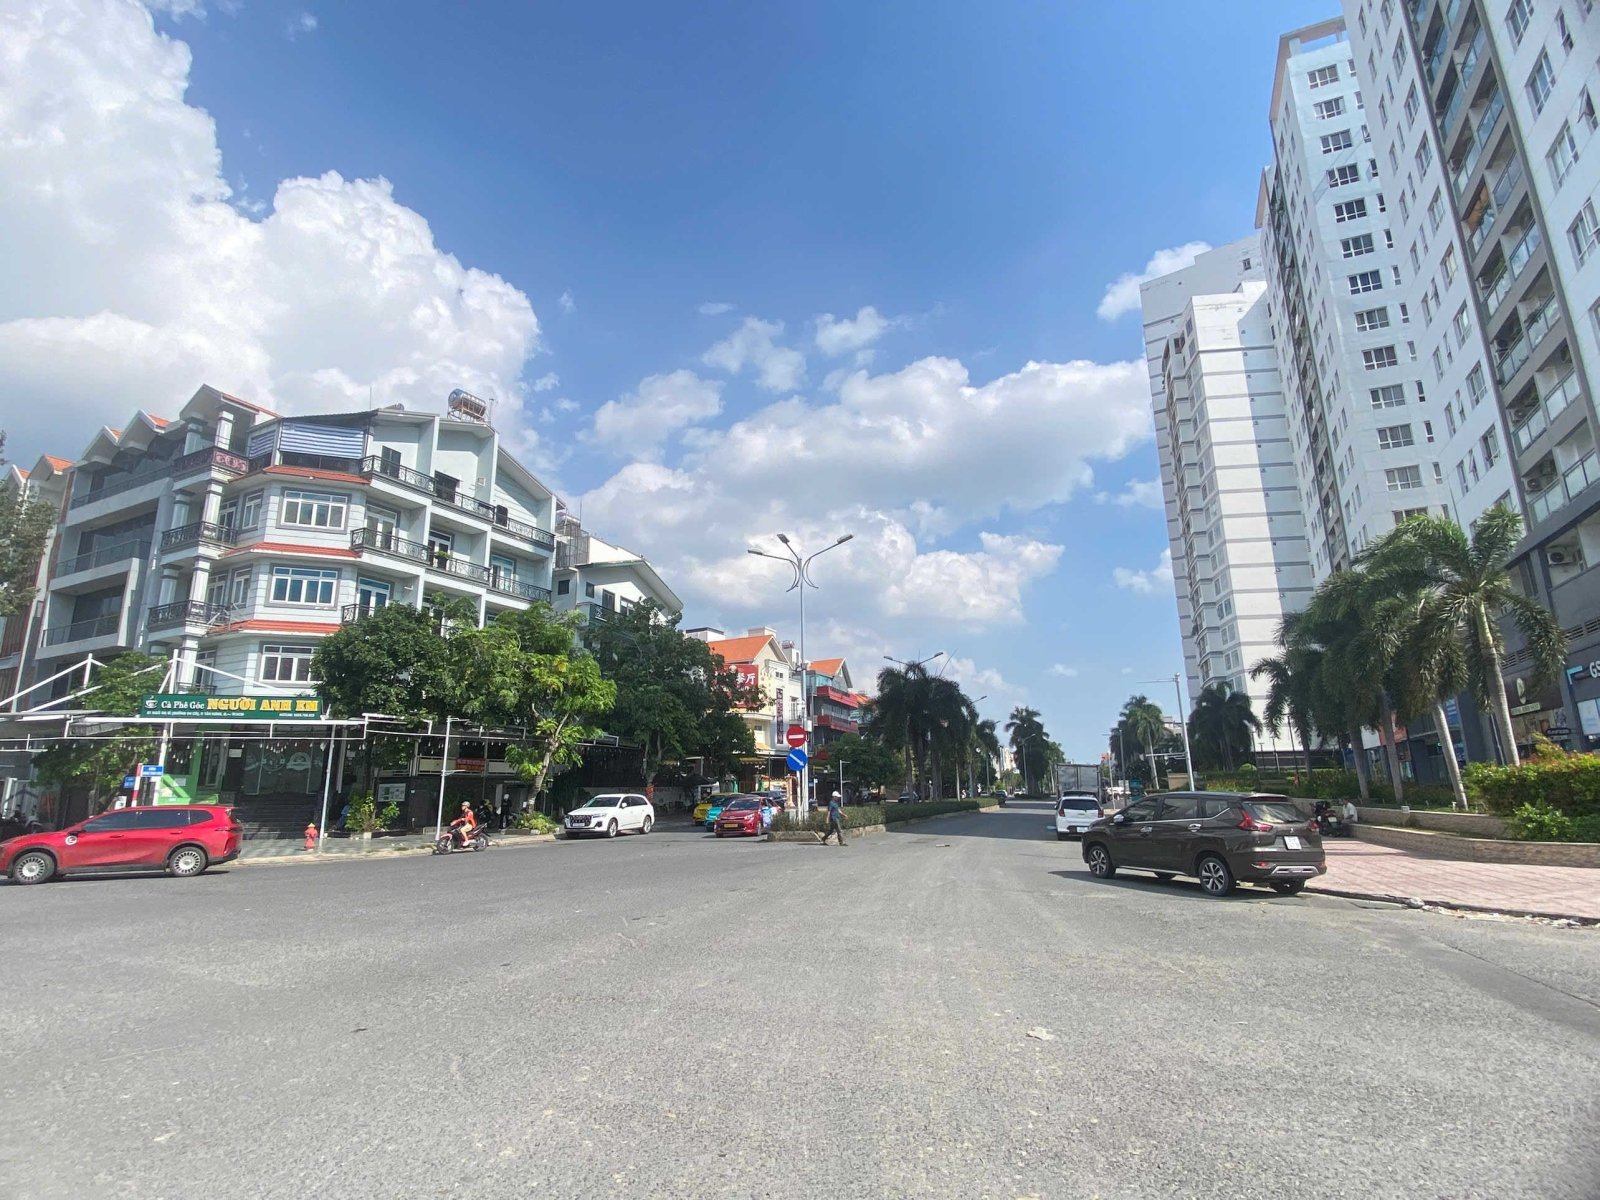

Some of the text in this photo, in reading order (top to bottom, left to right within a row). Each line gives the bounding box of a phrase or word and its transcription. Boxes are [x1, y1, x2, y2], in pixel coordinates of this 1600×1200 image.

[161, 700, 172, 709] Cà
[174, 701, 188, 709] Phê
[189, 701, 205, 710] Góc
[206, 696, 256, 711] NGƯỜI
[259, 699, 292, 712] ANH
